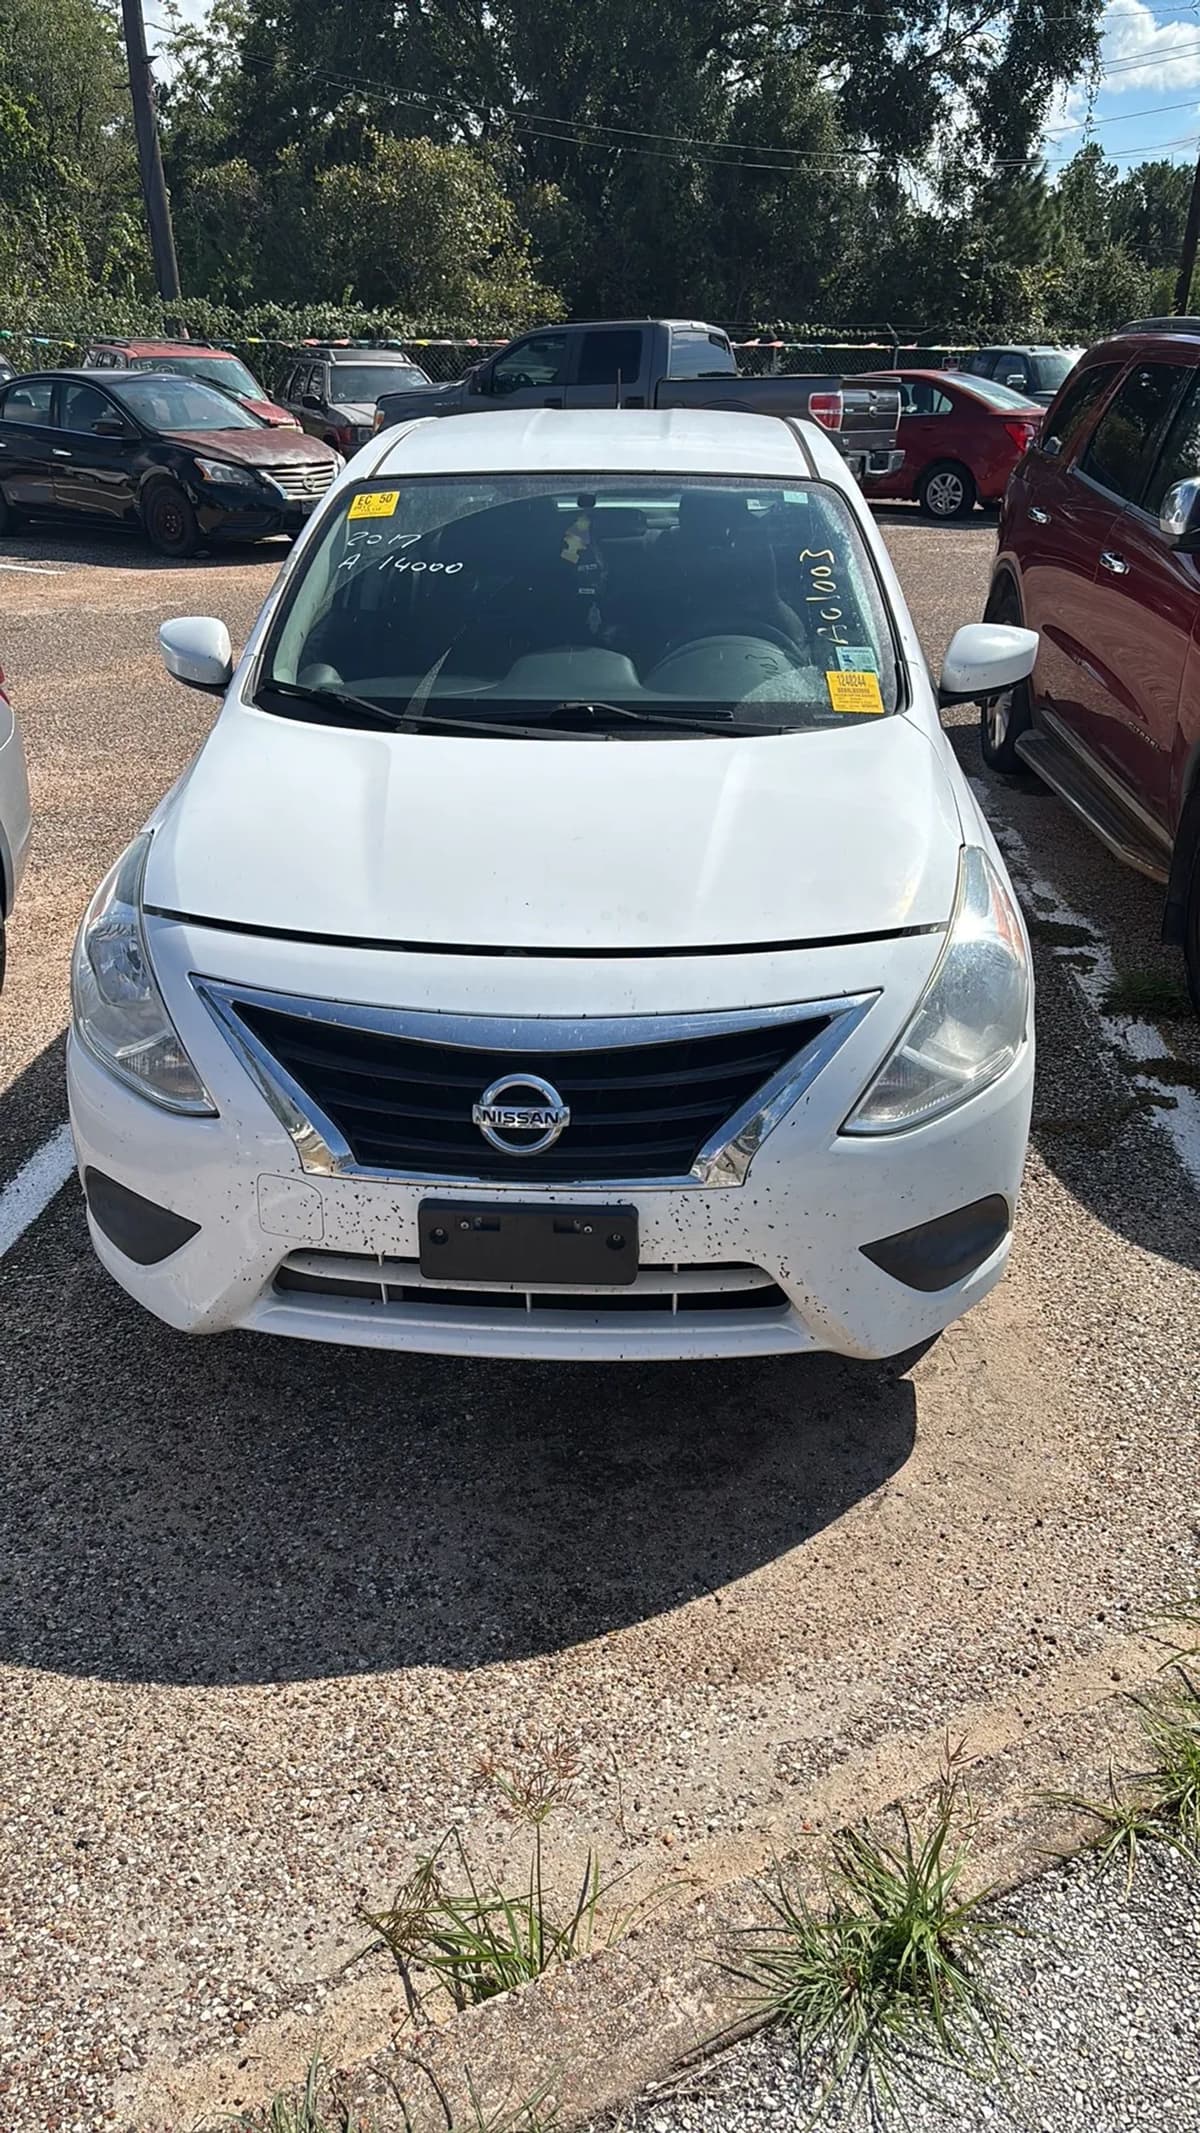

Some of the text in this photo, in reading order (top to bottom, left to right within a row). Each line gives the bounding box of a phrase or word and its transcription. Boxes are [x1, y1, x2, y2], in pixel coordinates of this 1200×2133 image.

[357, 493, 394, 506] EC 50
[347, 531, 422, 549] 2017
[338, 553, 464, 574] A 14000
[482, 1110, 560, 1125] NISSAN
